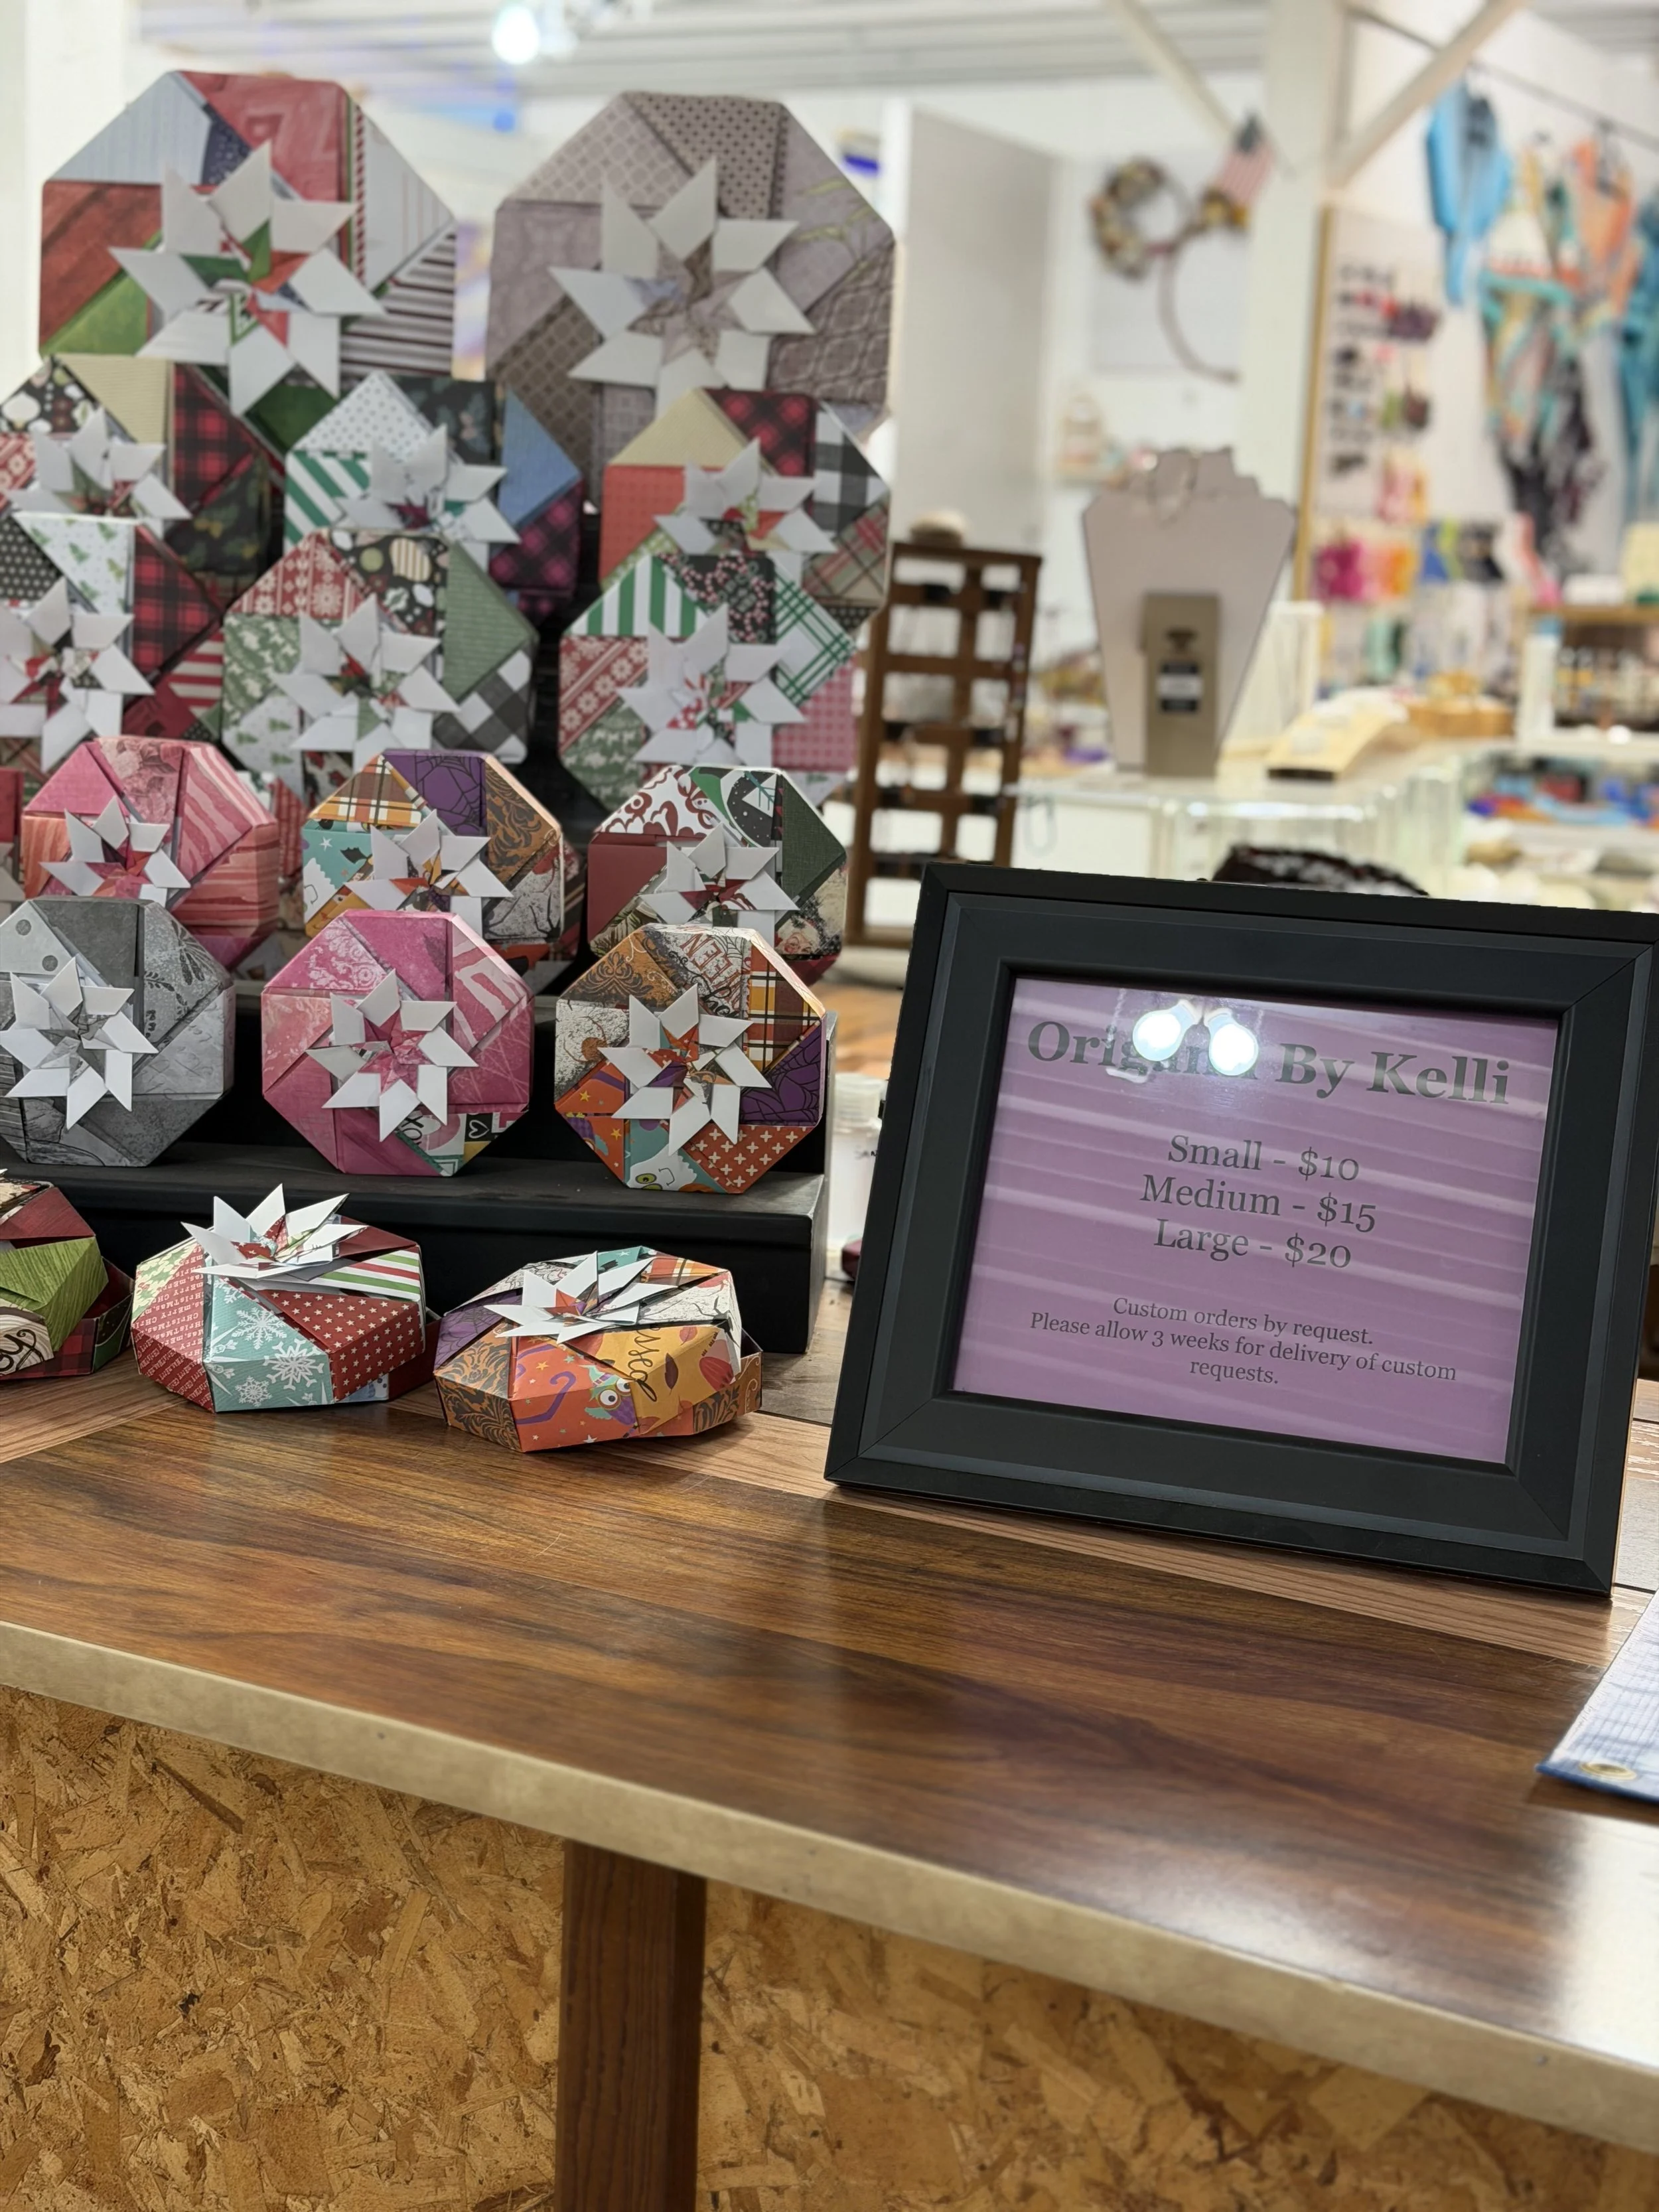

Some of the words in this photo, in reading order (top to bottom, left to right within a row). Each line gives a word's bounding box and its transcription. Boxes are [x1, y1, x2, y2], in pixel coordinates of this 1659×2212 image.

[1028, 1021, 1258, 1080] Origm
[1275, 1043, 1354, 1098] By
[1366, 1052, 1508, 1104] Kelli
[1168, 1136, 1262, 1170] Small
[1299, 1147, 1358, 1181] $10
[1139, 1175, 1279, 1216] Medium
[1317, 1192, 1376, 1232] $15
[1154, 1218, 1248, 1261] Large
[1285, 1232, 1350, 1268] $20
[1031, 1313, 1090, 1333] Please
[1096, 1320, 1148, 1341] allow
[1152, 1331, 1163, 1347] 3
[1171, 1333, 1229, 1351] weeks
[1235, 1336, 1265, 1355] for
[1270, 1340, 1351, 1370] delivery
[1356, 1353, 1379, 1370] of
[1382, 1361, 1455, 1380] custom
[1114, 1298, 1187, 1321] Custom
[1194, 1309, 1257, 1329] orders
[1263, 1314, 1287, 1337] by
[1293, 1323, 1372, 1347] request.
[1190, 1362, 1277, 1384] requests.
